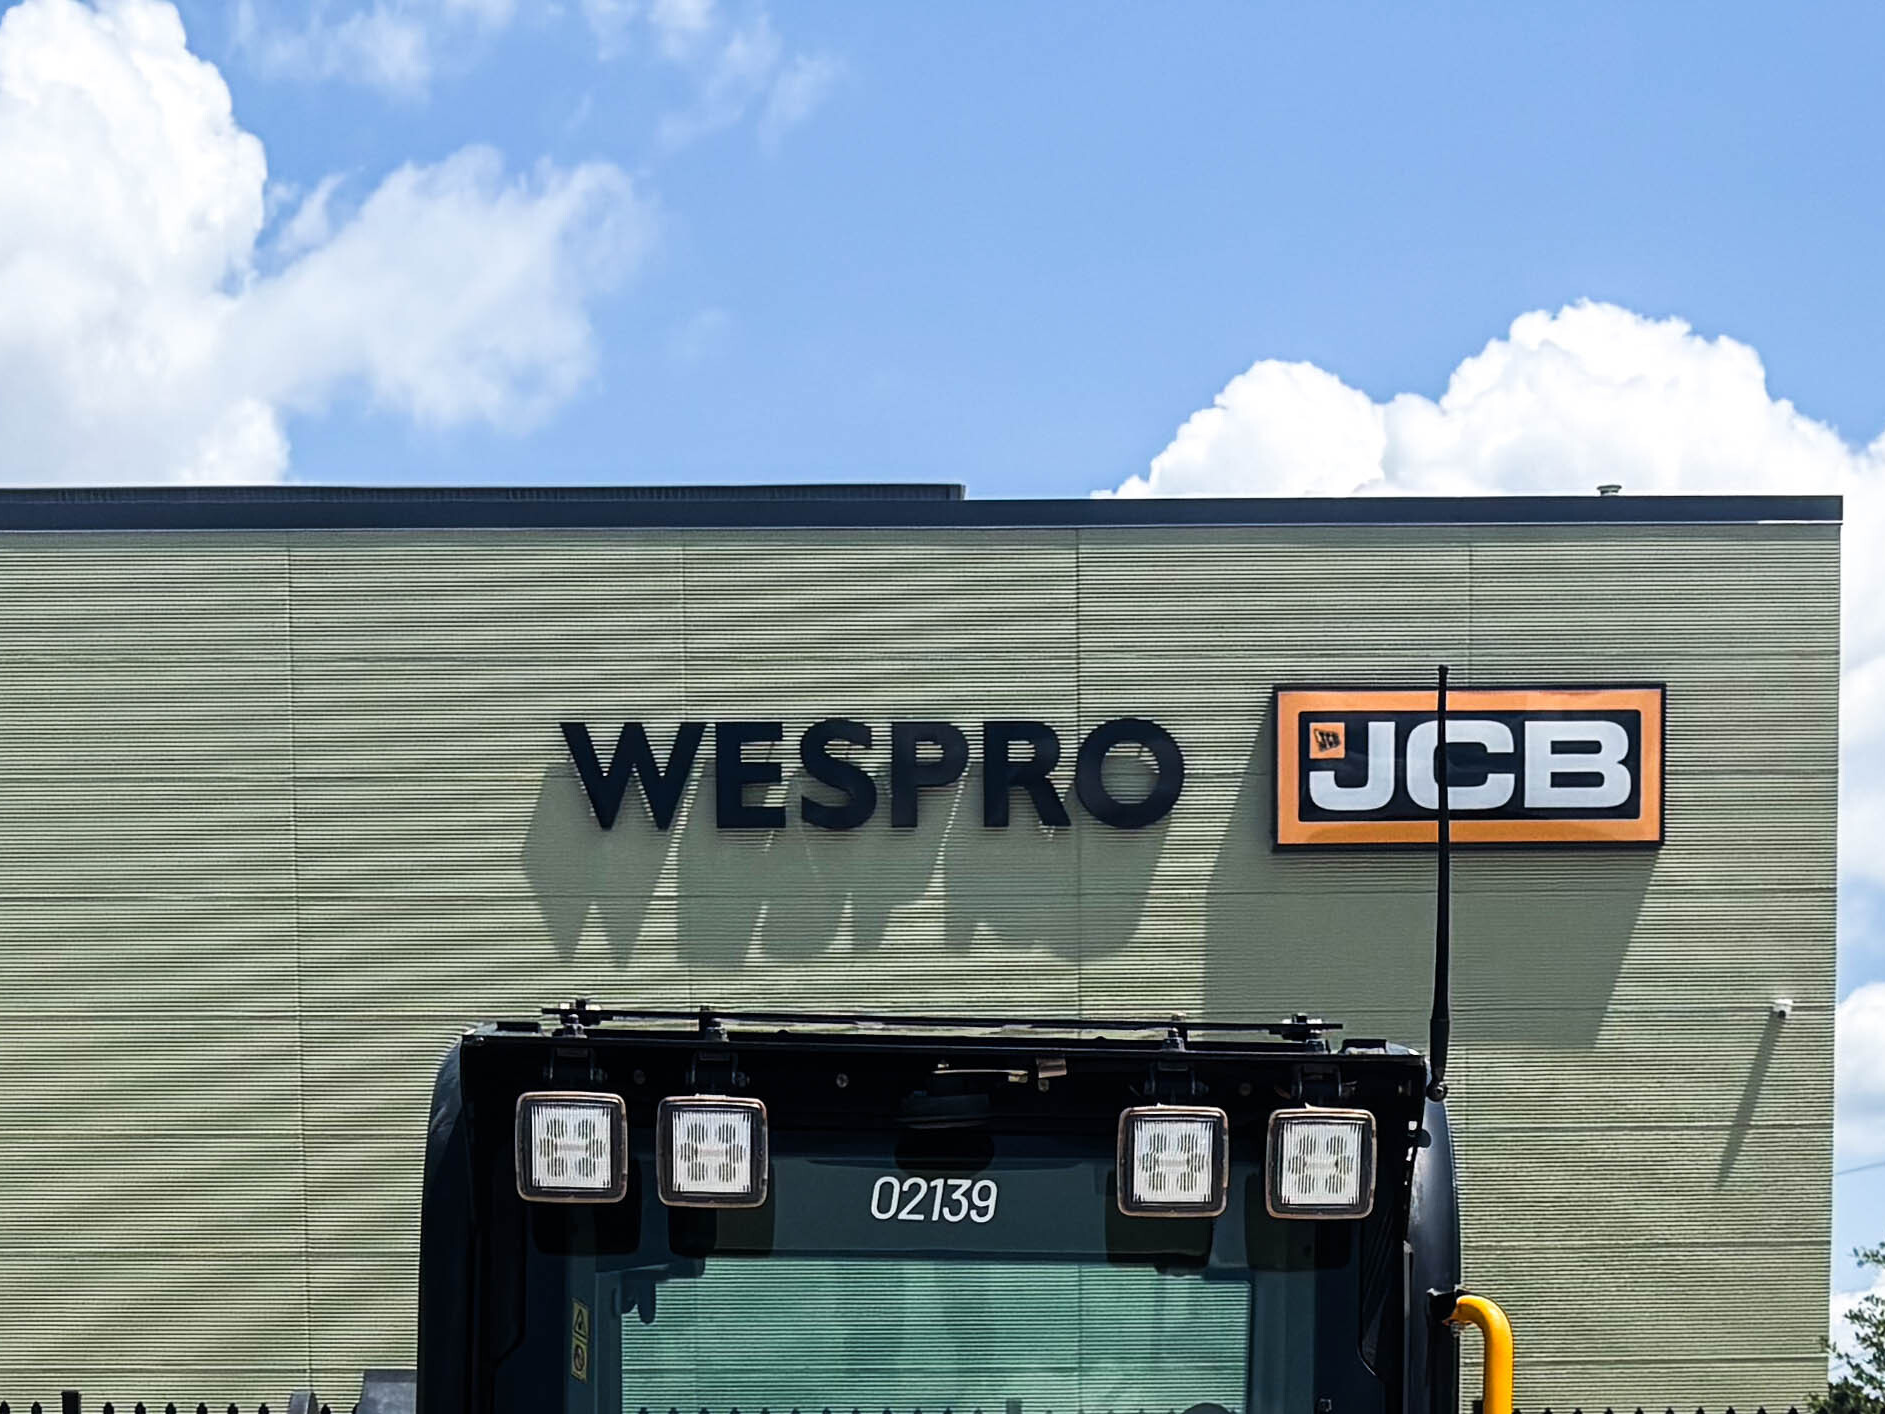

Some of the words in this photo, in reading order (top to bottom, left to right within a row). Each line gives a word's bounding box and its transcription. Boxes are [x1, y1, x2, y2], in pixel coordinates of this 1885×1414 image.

[559, 718, 1186, 830] WESPRO
[1309, 720, 1632, 811] JCB
[871, 1176, 998, 1223] 02139
